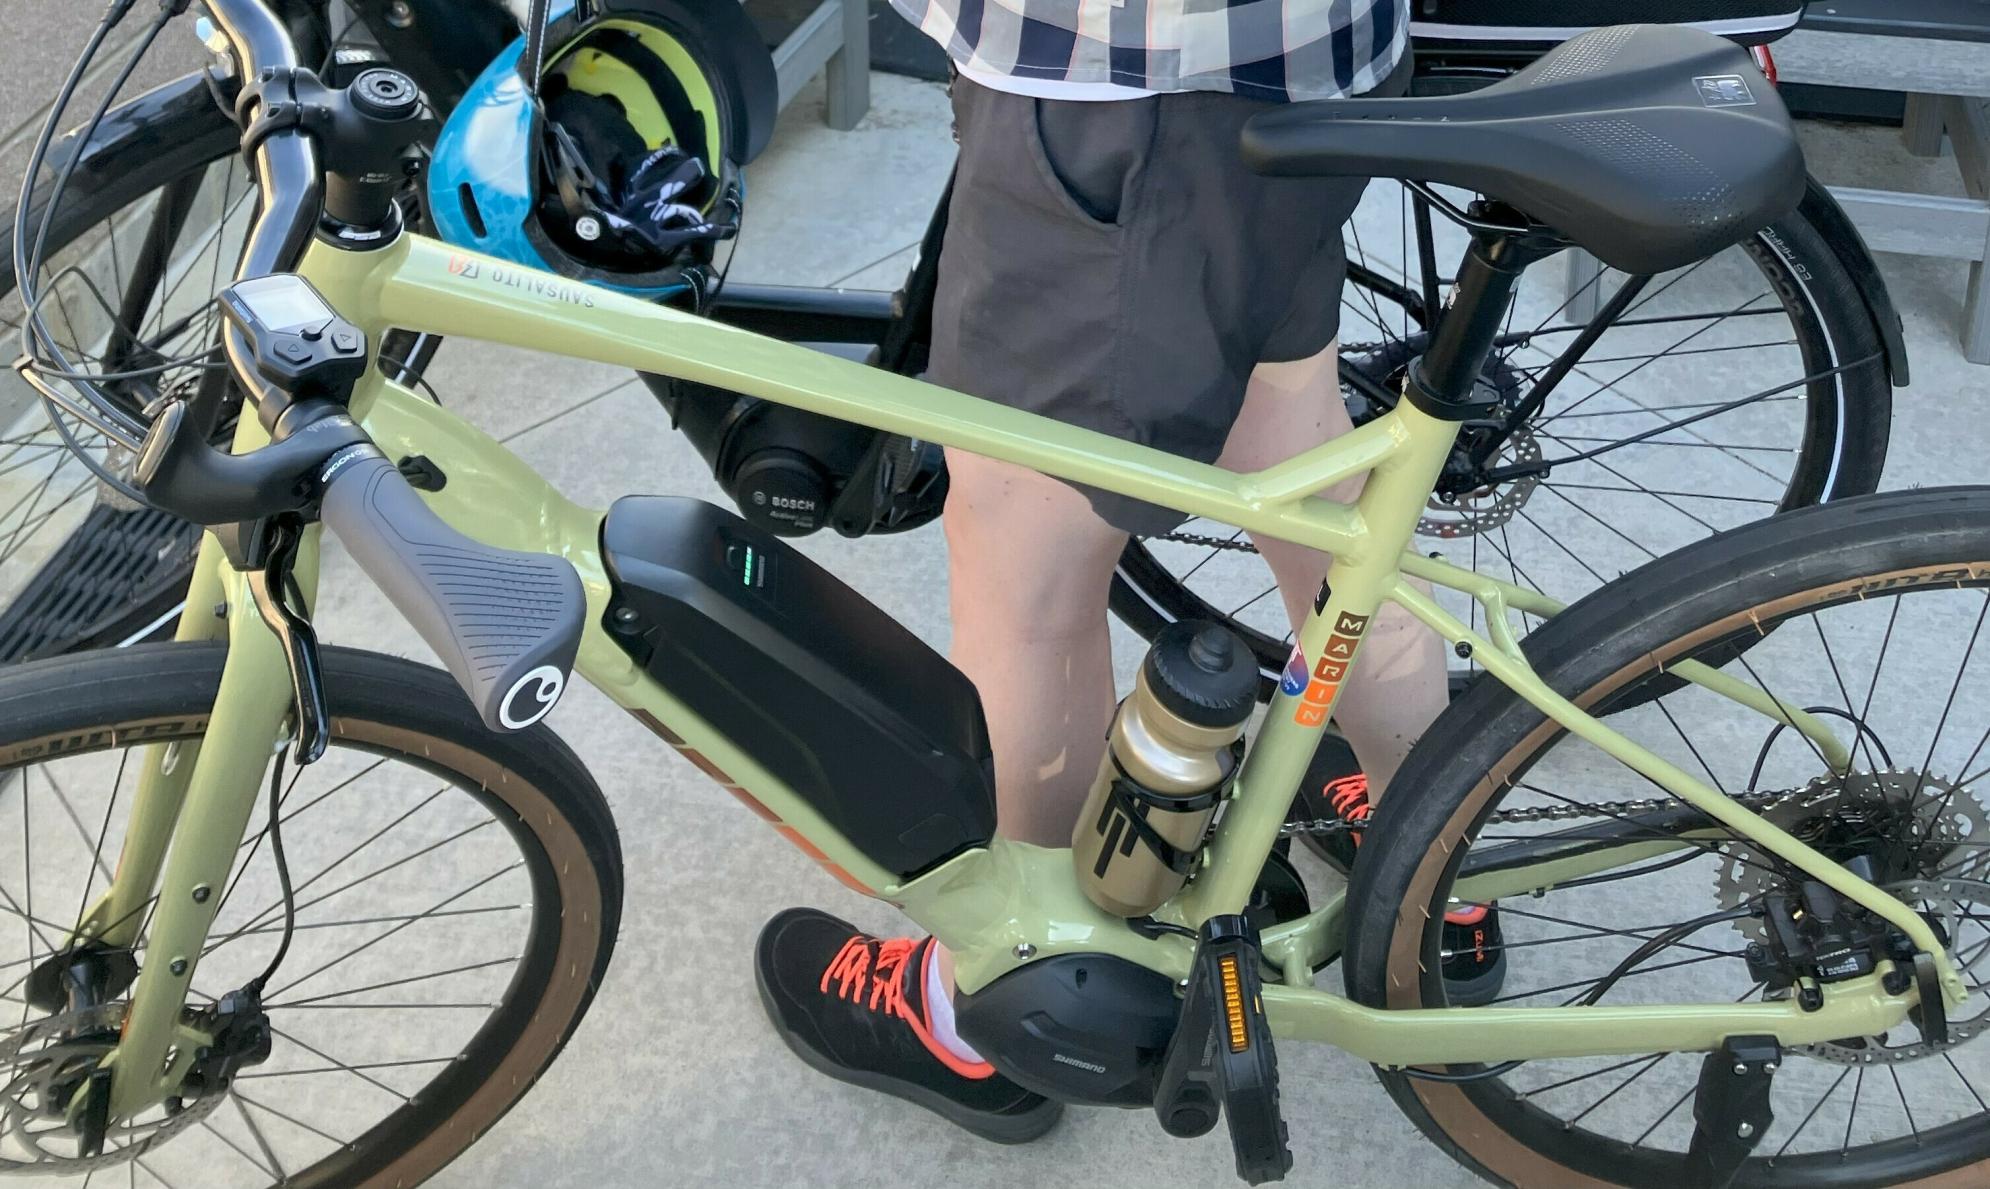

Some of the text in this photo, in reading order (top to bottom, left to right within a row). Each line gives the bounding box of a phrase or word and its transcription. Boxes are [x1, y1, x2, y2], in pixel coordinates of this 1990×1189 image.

[492, 268, 595, 309] SAUSALITO
[321, 452, 356, 483] ERGON
[771, 496, 815, 511] BOSCH
[1298, 612, 1367, 725] MARIN
[1053, 1053, 1106, 1074] SHIMANO
